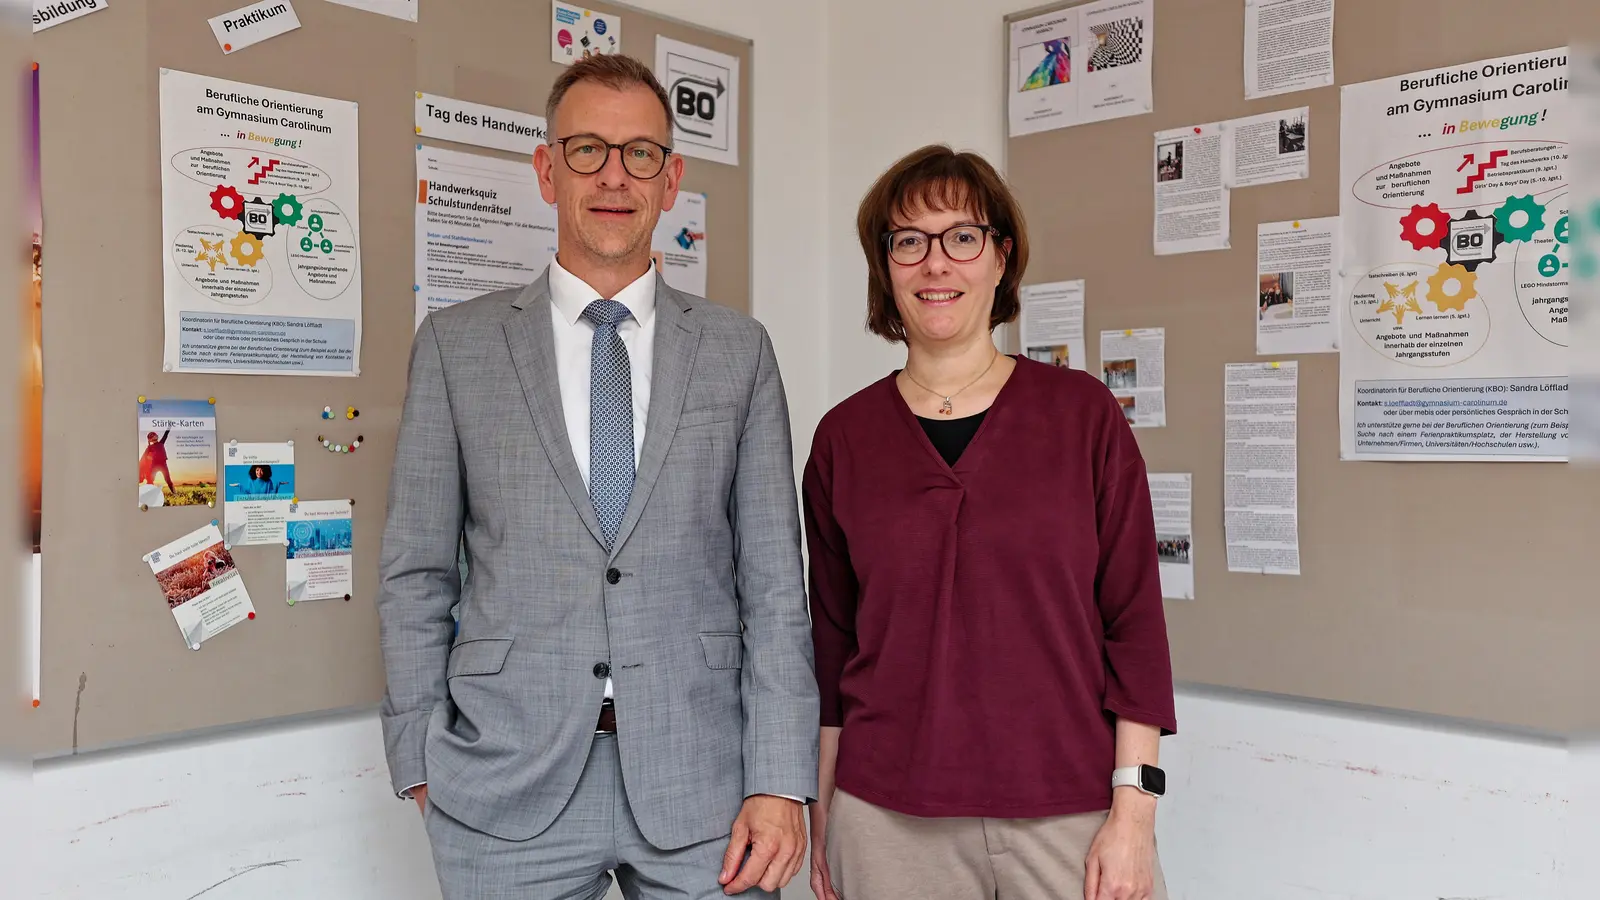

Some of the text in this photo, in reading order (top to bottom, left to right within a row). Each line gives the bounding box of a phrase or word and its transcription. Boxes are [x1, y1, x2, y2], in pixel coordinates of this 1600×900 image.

[223, 2, 287, 32] Praktikum
[1400, 70, 1478, 91] Berufliche
[206, 89, 323, 118] Berufliche Orientierung
[677, 85, 714, 120] BO
[1387, 104, 1409, 116] am
[1414, 88, 1507, 113] Gymnasium
[197, 106, 332, 134] am Gymnasium Carolinum
[426, 104, 547, 140] Tag des Handwerks
[1442, 123, 1455, 135] in
[1459, 112, 1539, 132] Bewegung
[237, 131, 246, 139] in
[248, 133, 297, 148] Bewegung
[1511, 145, 1556, 155] Berufsberatungen
[200, 157, 230, 165] Maßnahmen
[1389, 161, 1420, 169] Angebote
[1520, 156, 1549, 164] Handwerks
[196, 171, 226, 179] Orientierung
[1389, 170, 1431, 179] Maßnahmen
[1487, 168, 1534, 177] Betriebspraktikum
[1391, 179, 1430, 188] beruflichen
[429, 181, 497, 200] Handwerksquiz
[1382, 190, 1424, 199] Orientierung
[428, 196, 511, 215] Schulstundenrätsel
[250, 213, 267, 224] BO
[1457, 233, 1483, 248] BO
[1532, 297, 1568, 305] jahrgangs
[1442, 386, 1484, 394] Orientierung
[1485, 385, 1508, 393] (KBO):
[1497, 408, 1531, 416] Gespräch
[152, 420, 204, 428] Stärke-Karten
